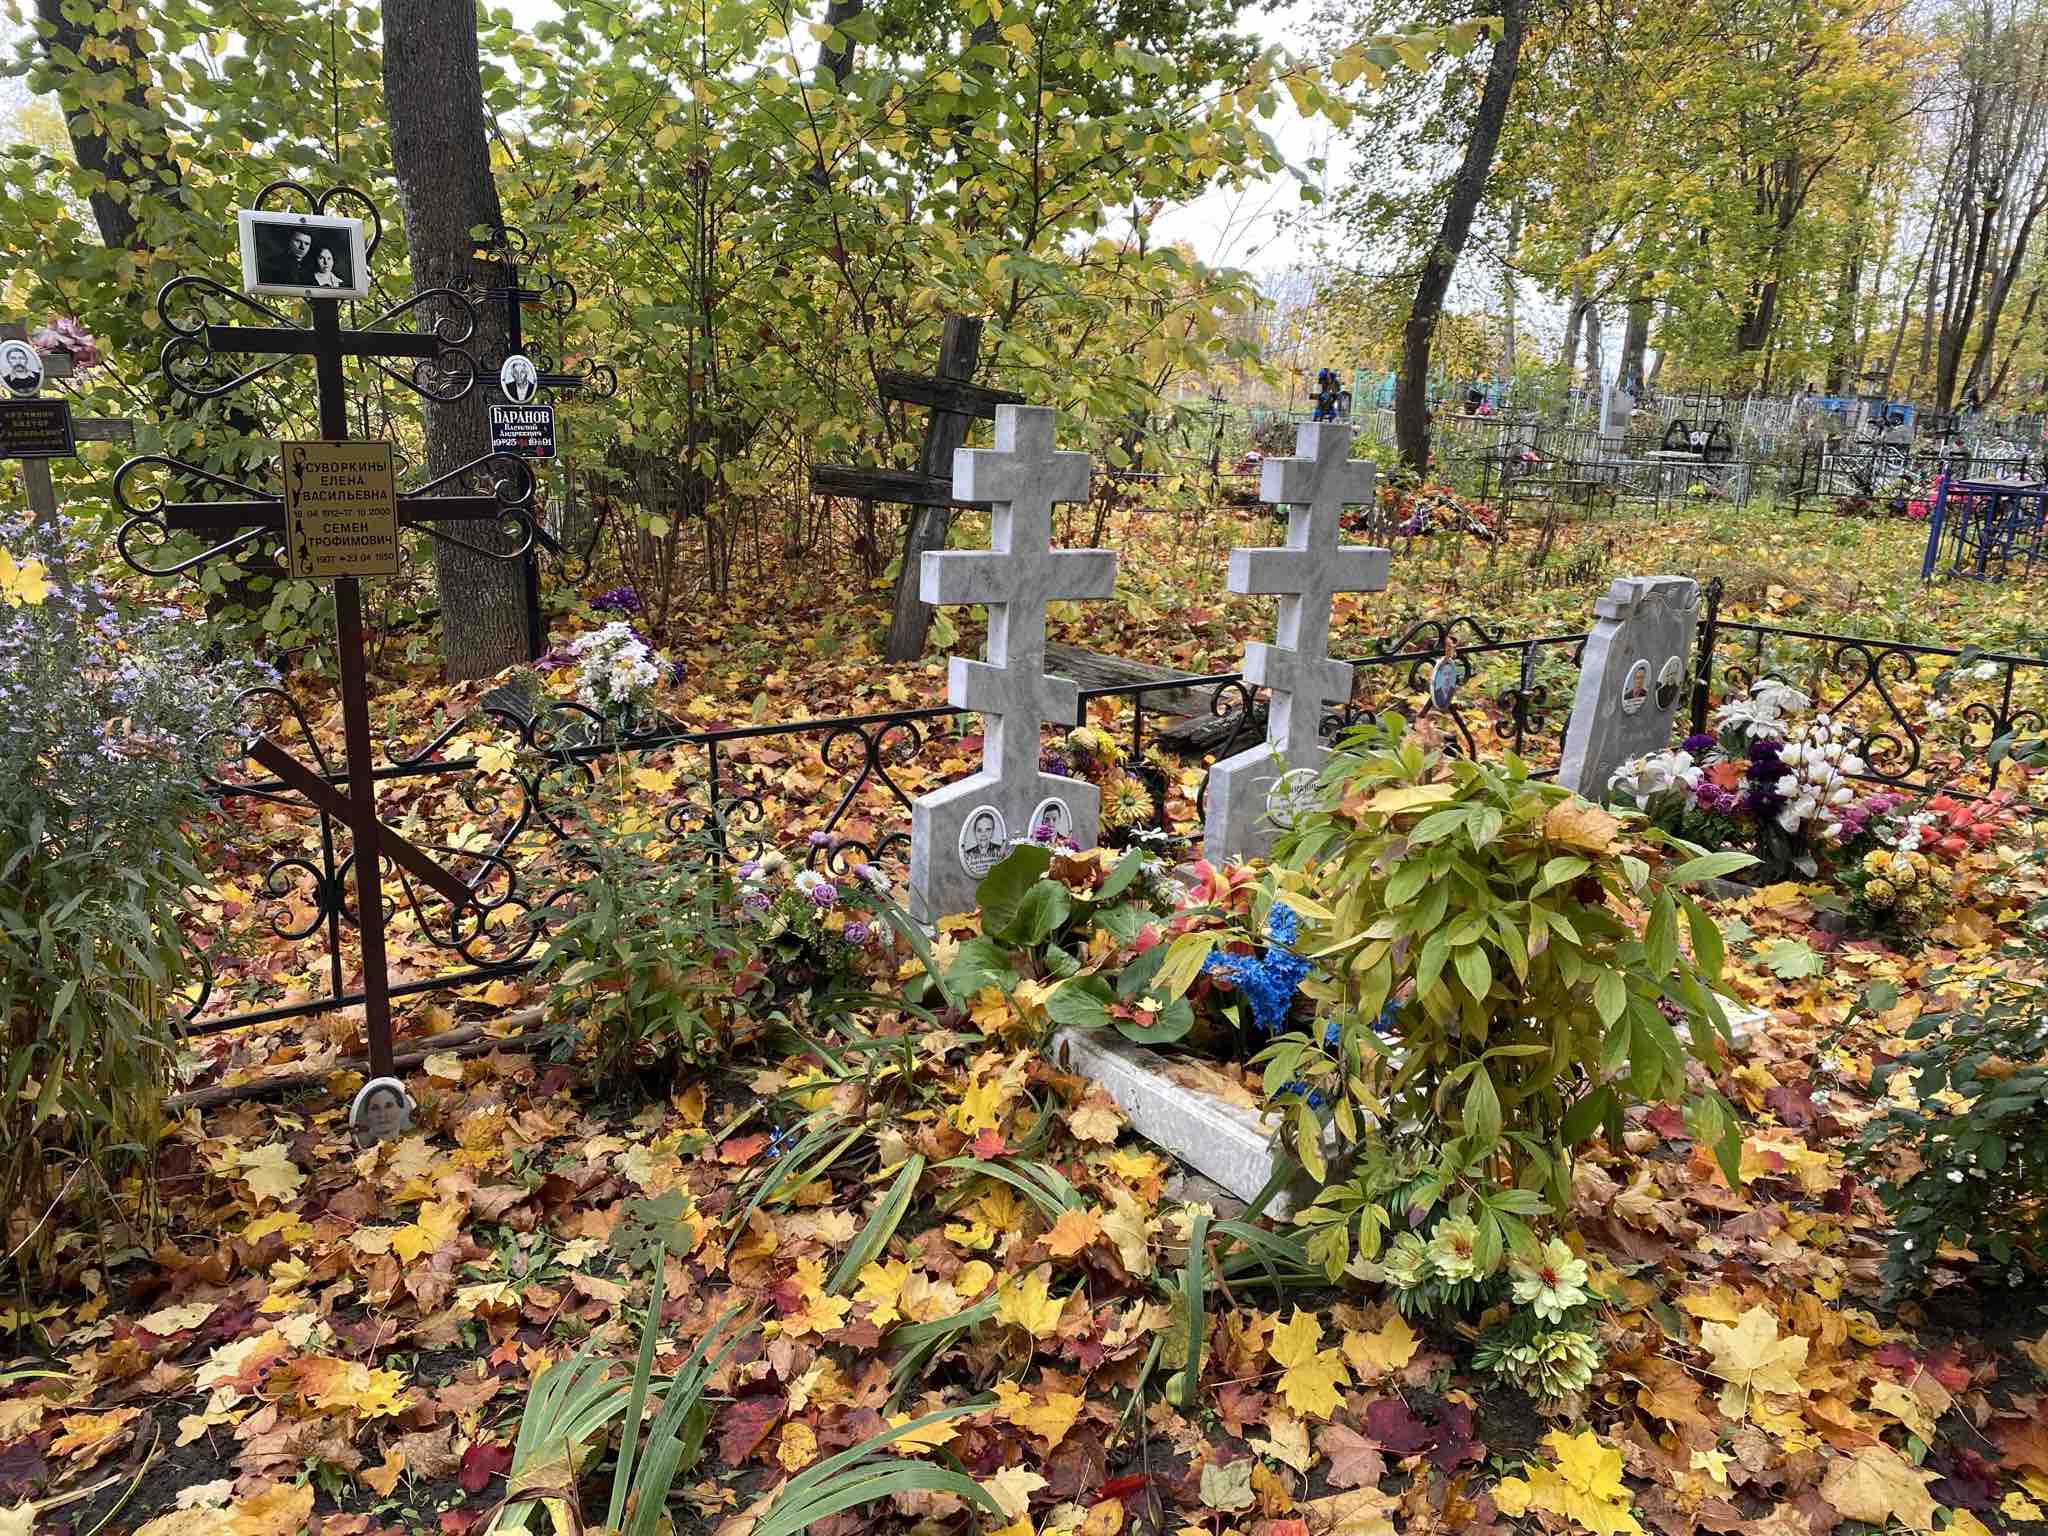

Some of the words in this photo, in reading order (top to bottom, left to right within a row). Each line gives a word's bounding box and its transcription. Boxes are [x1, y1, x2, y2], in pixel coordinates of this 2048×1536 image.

[493, 408, 549, 423] БАРАНОВ
[305, 461, 387, 473] СУВОРКИНЫ
[320, 476, 365, 486] ЕЛЕНА
[303, 490, 388, 501] ВАСИЛЬЕВНА
[323, 522, 369, 533] СЕМЕН
[308, 535, 393, 547] ТРОФИМОВИЧ
